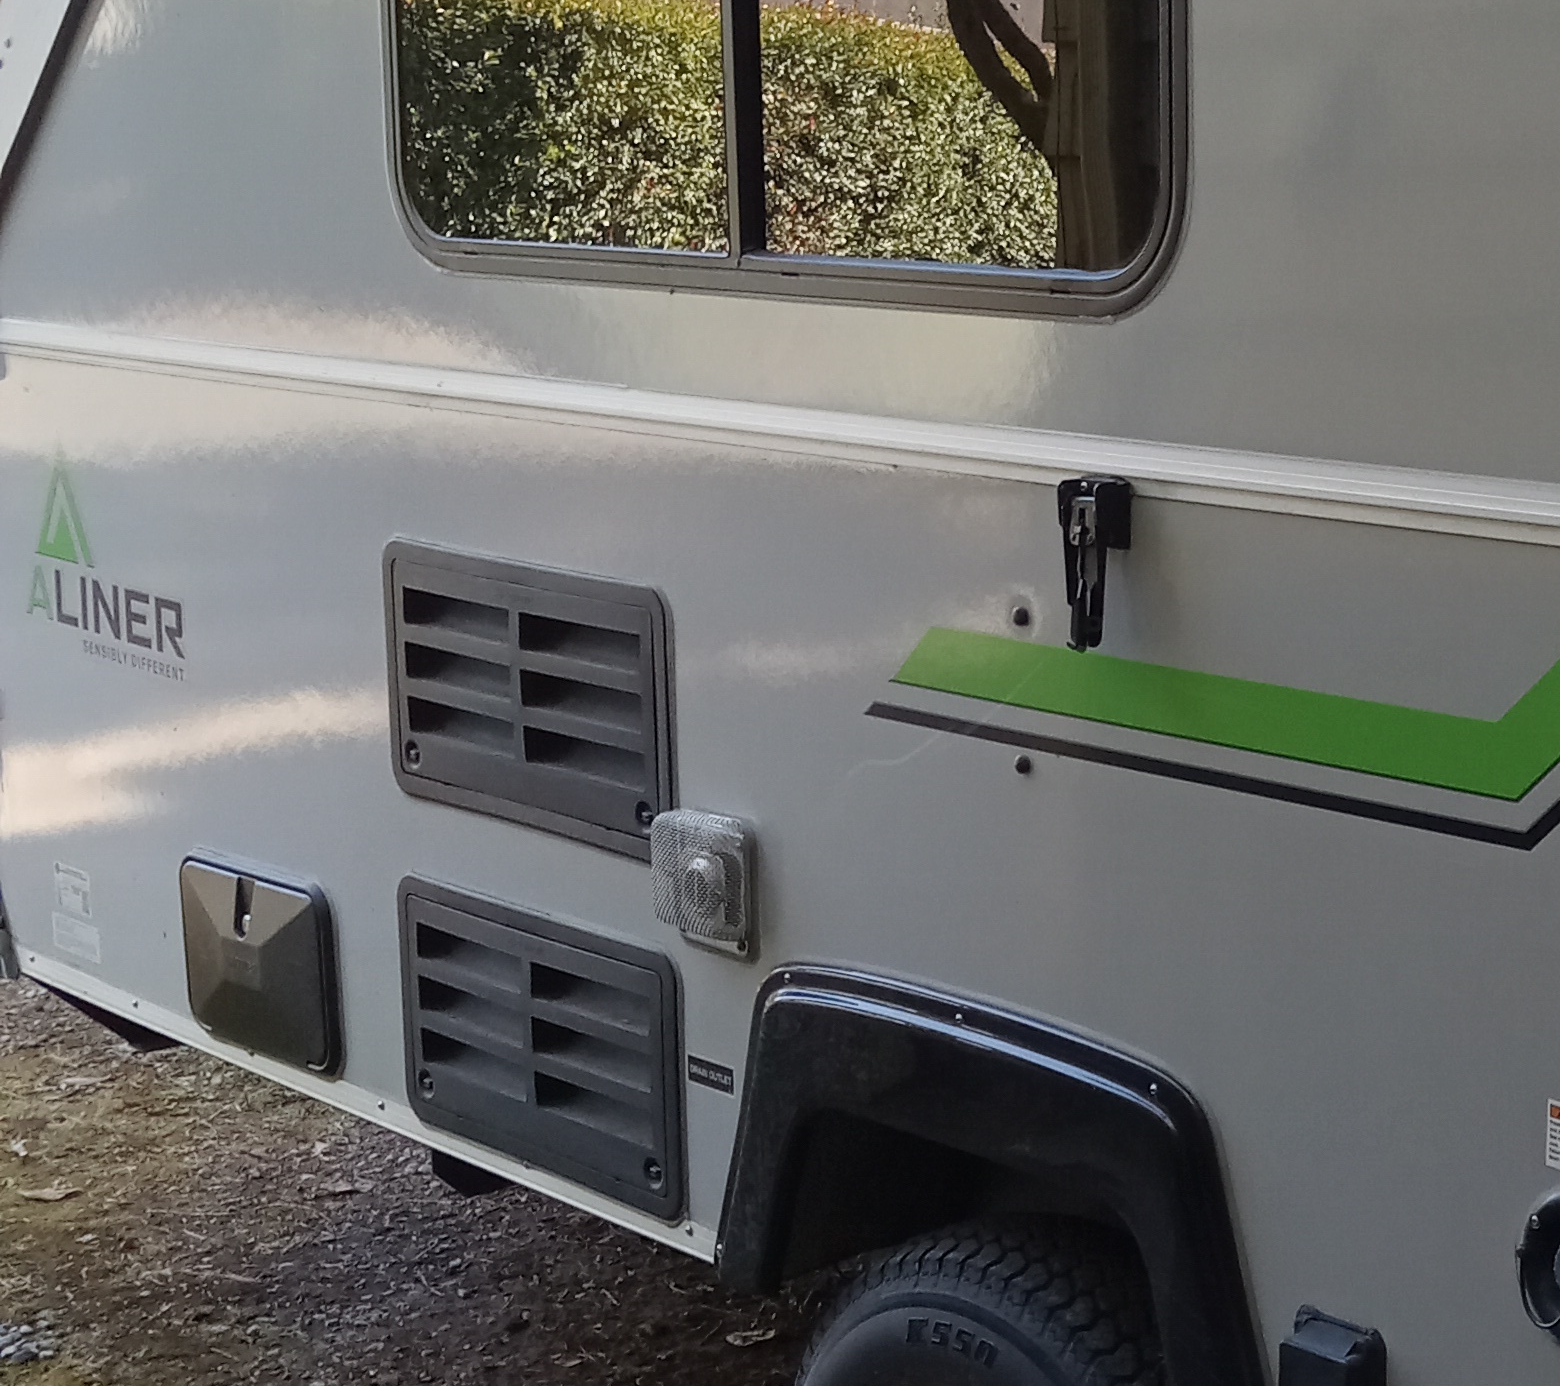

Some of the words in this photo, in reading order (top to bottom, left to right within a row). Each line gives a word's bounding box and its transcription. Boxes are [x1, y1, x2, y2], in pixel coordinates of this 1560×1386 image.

[26, 565, 185, 660] ALINER
[82, 639, 127, 665] SENSIBLY
[131, 654, 185, 682] DIFFERENT
